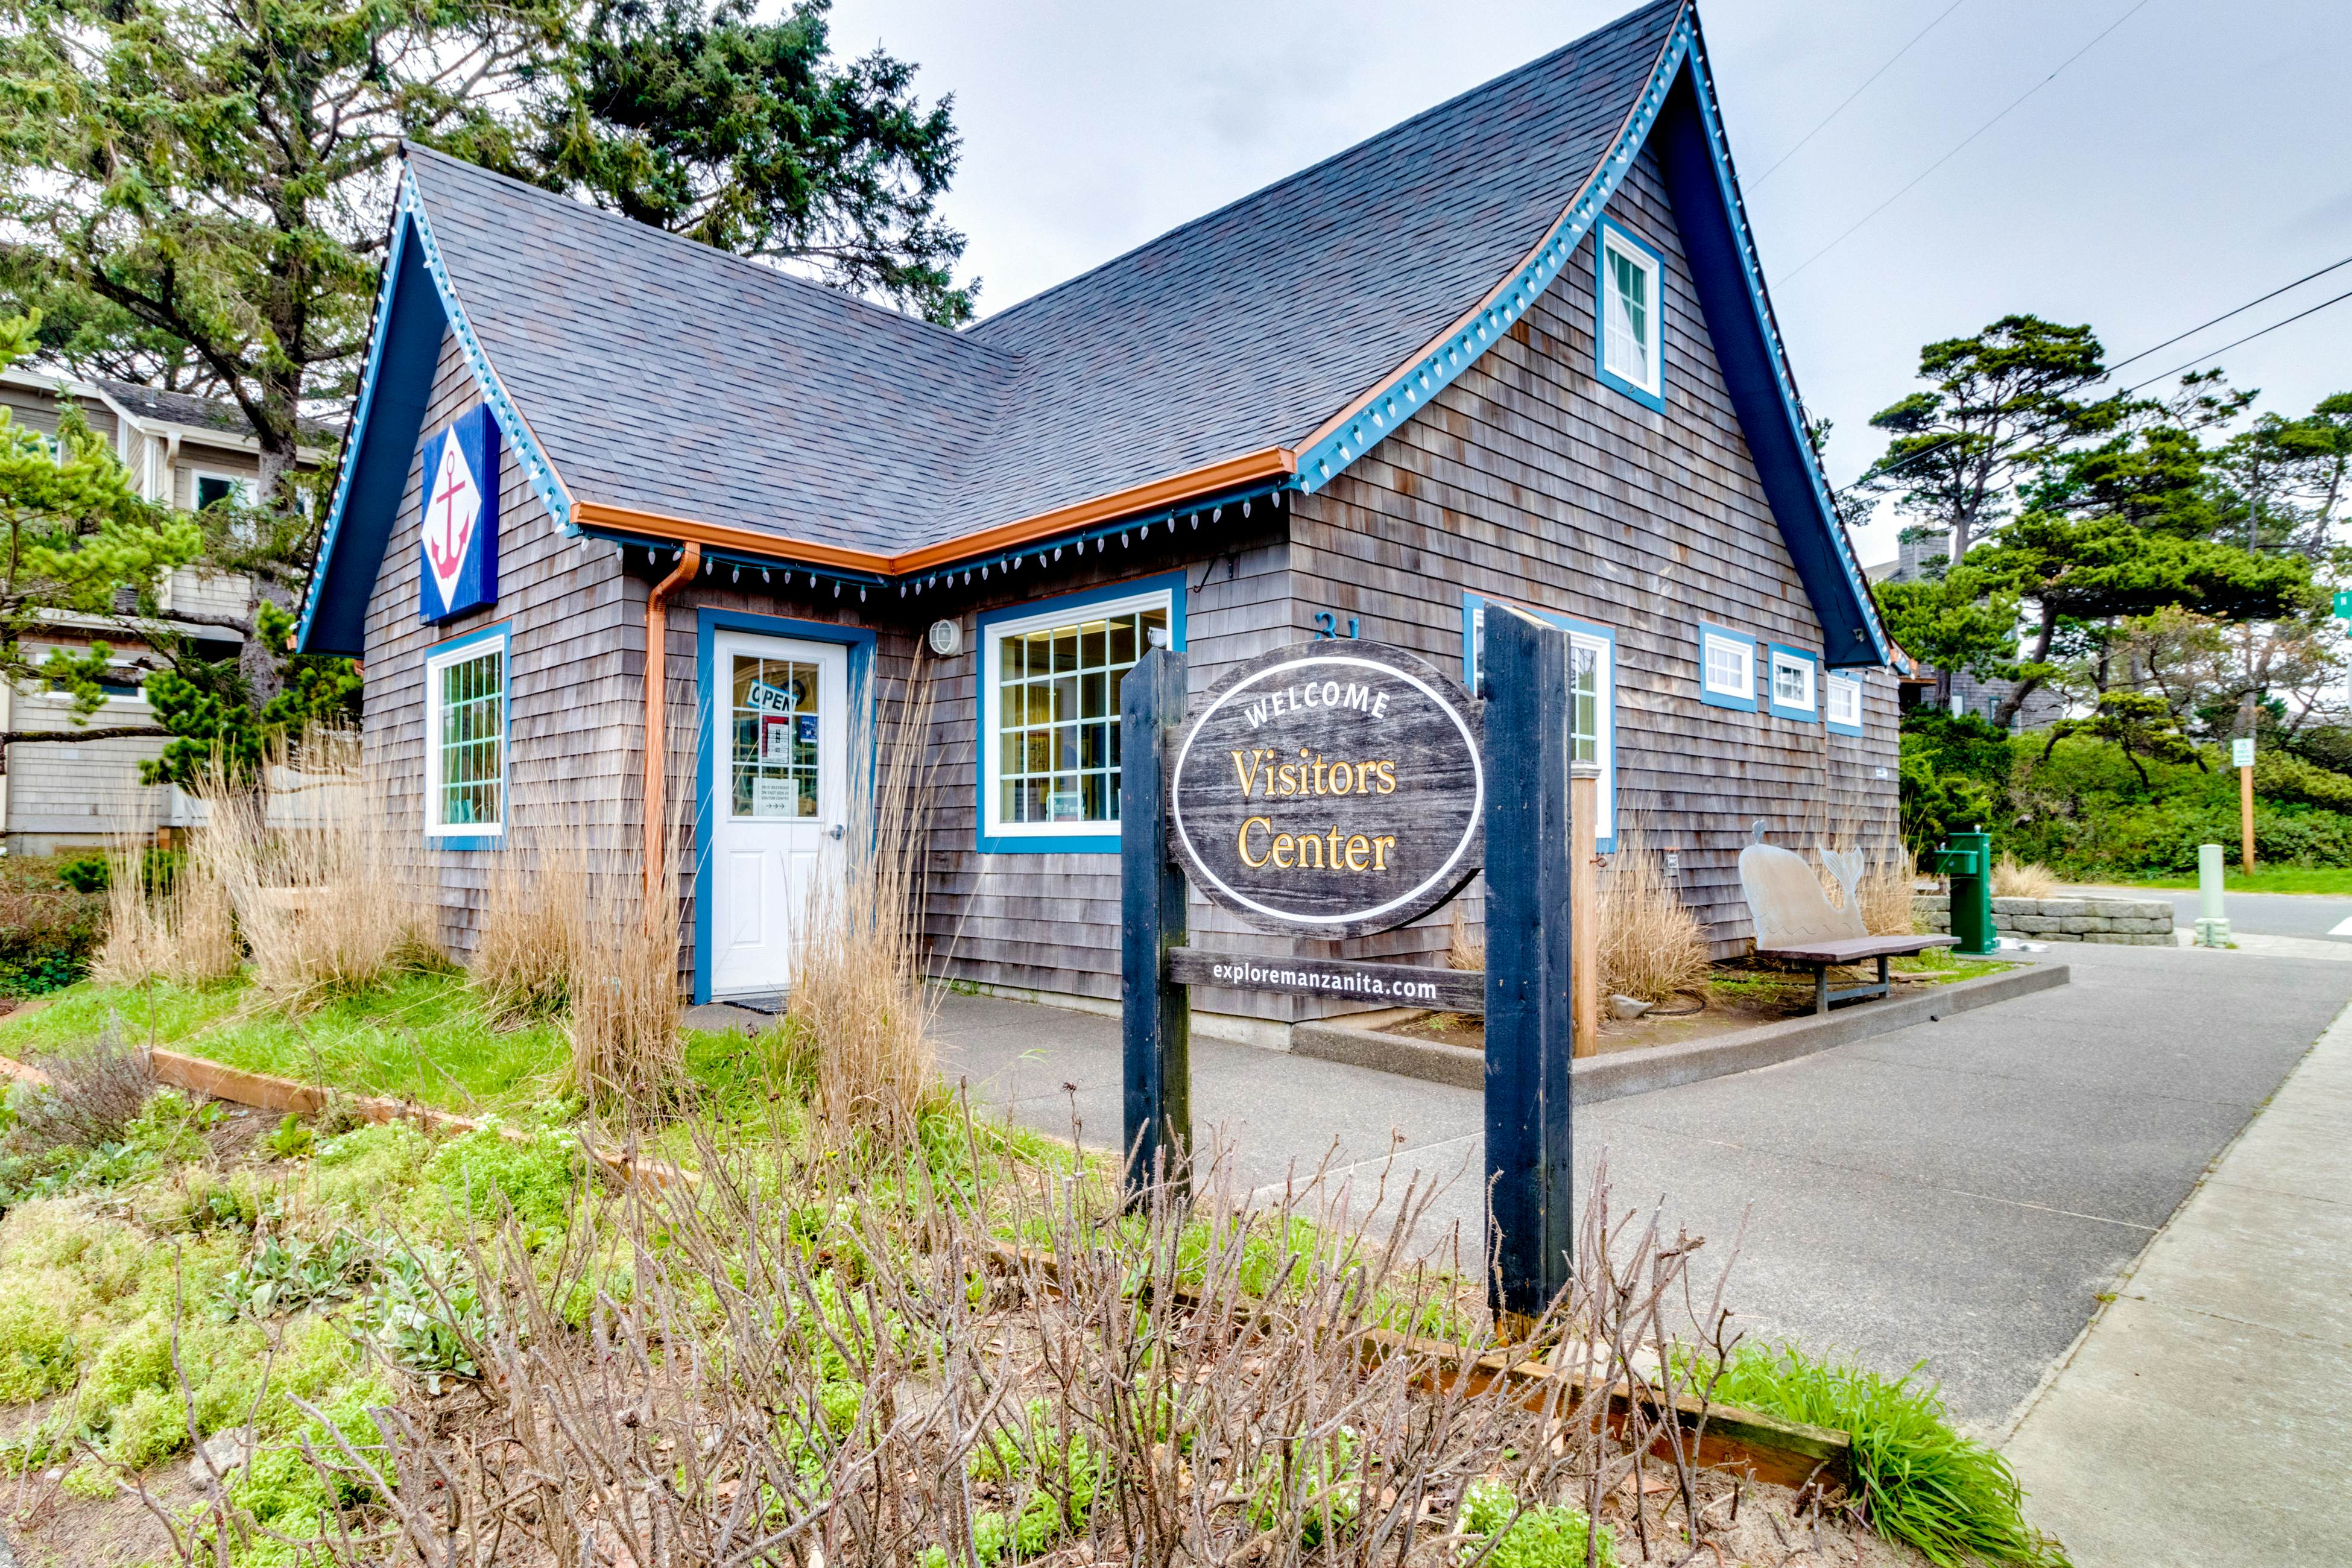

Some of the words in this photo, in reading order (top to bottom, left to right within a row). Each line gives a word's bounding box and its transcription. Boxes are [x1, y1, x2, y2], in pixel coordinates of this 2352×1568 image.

[751, 686, 795, 712] OPEN
[1244, 680, 1390, 729] WELCOME
[1230, 748, 1397, 797] Visitors
[1238, 816, 1396, 871] Center
[1213, 962, 1437, 999] exploremanzanita.com
